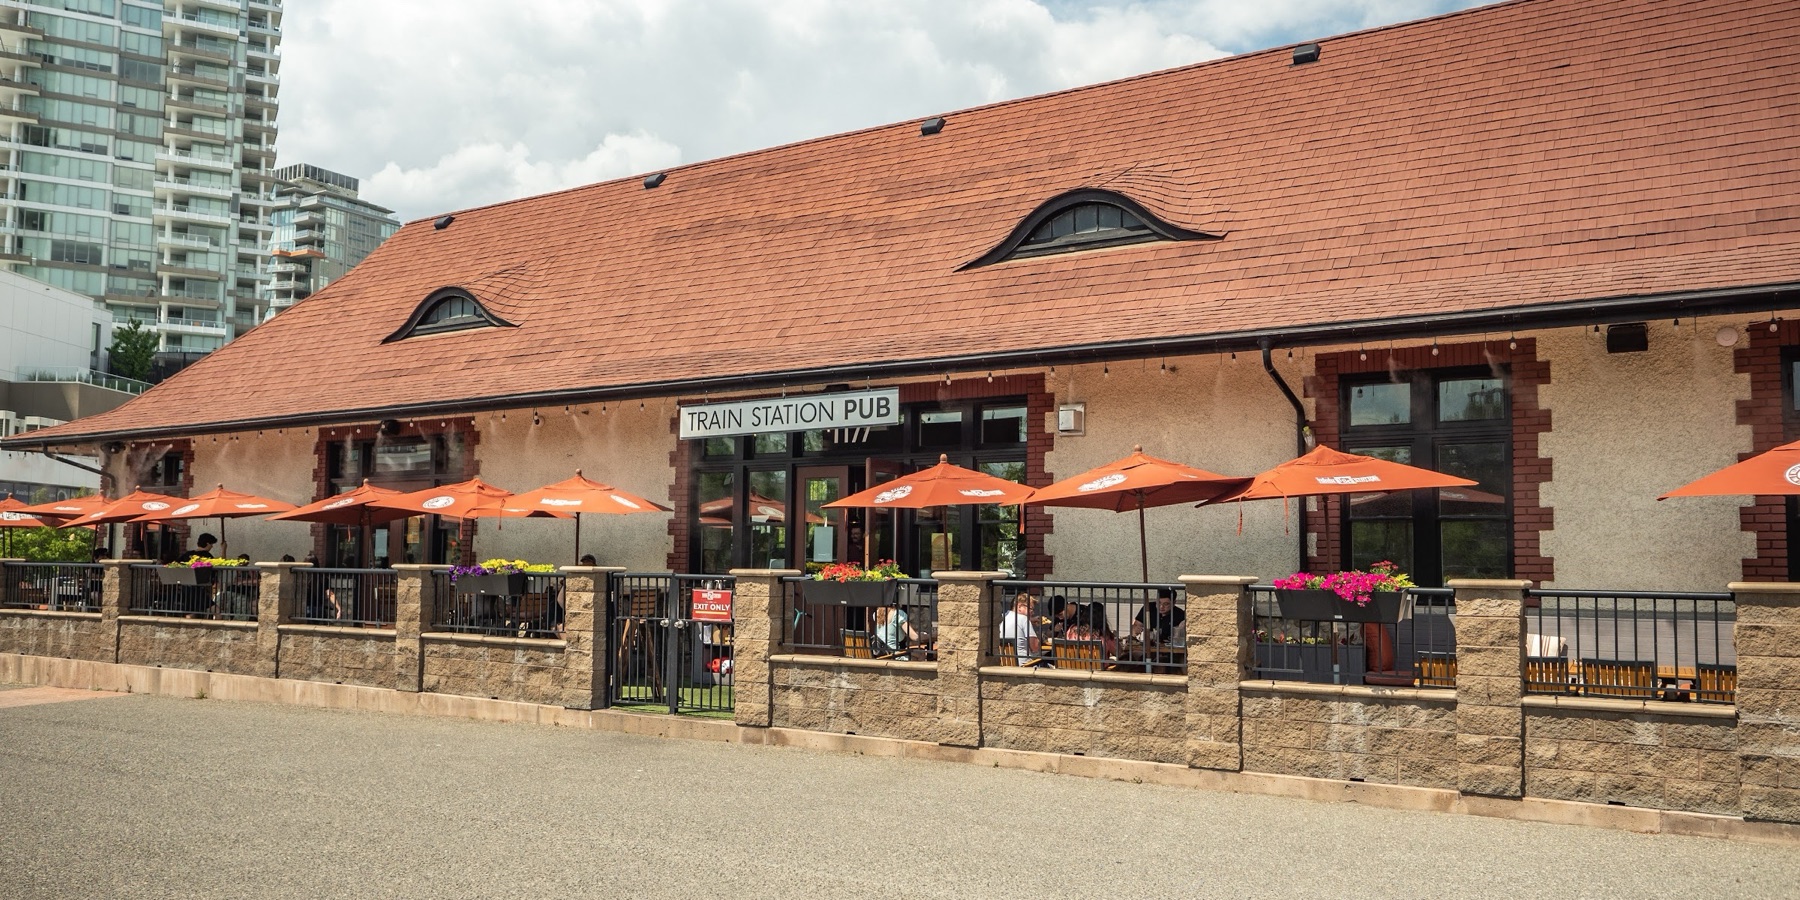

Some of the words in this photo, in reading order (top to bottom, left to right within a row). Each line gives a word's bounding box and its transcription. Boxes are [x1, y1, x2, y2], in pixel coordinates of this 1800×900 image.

[687, 408, 742, 431] TRAIN
[751, 401, 834, 427] STATION
[844, 396, 891, 420] PUB
